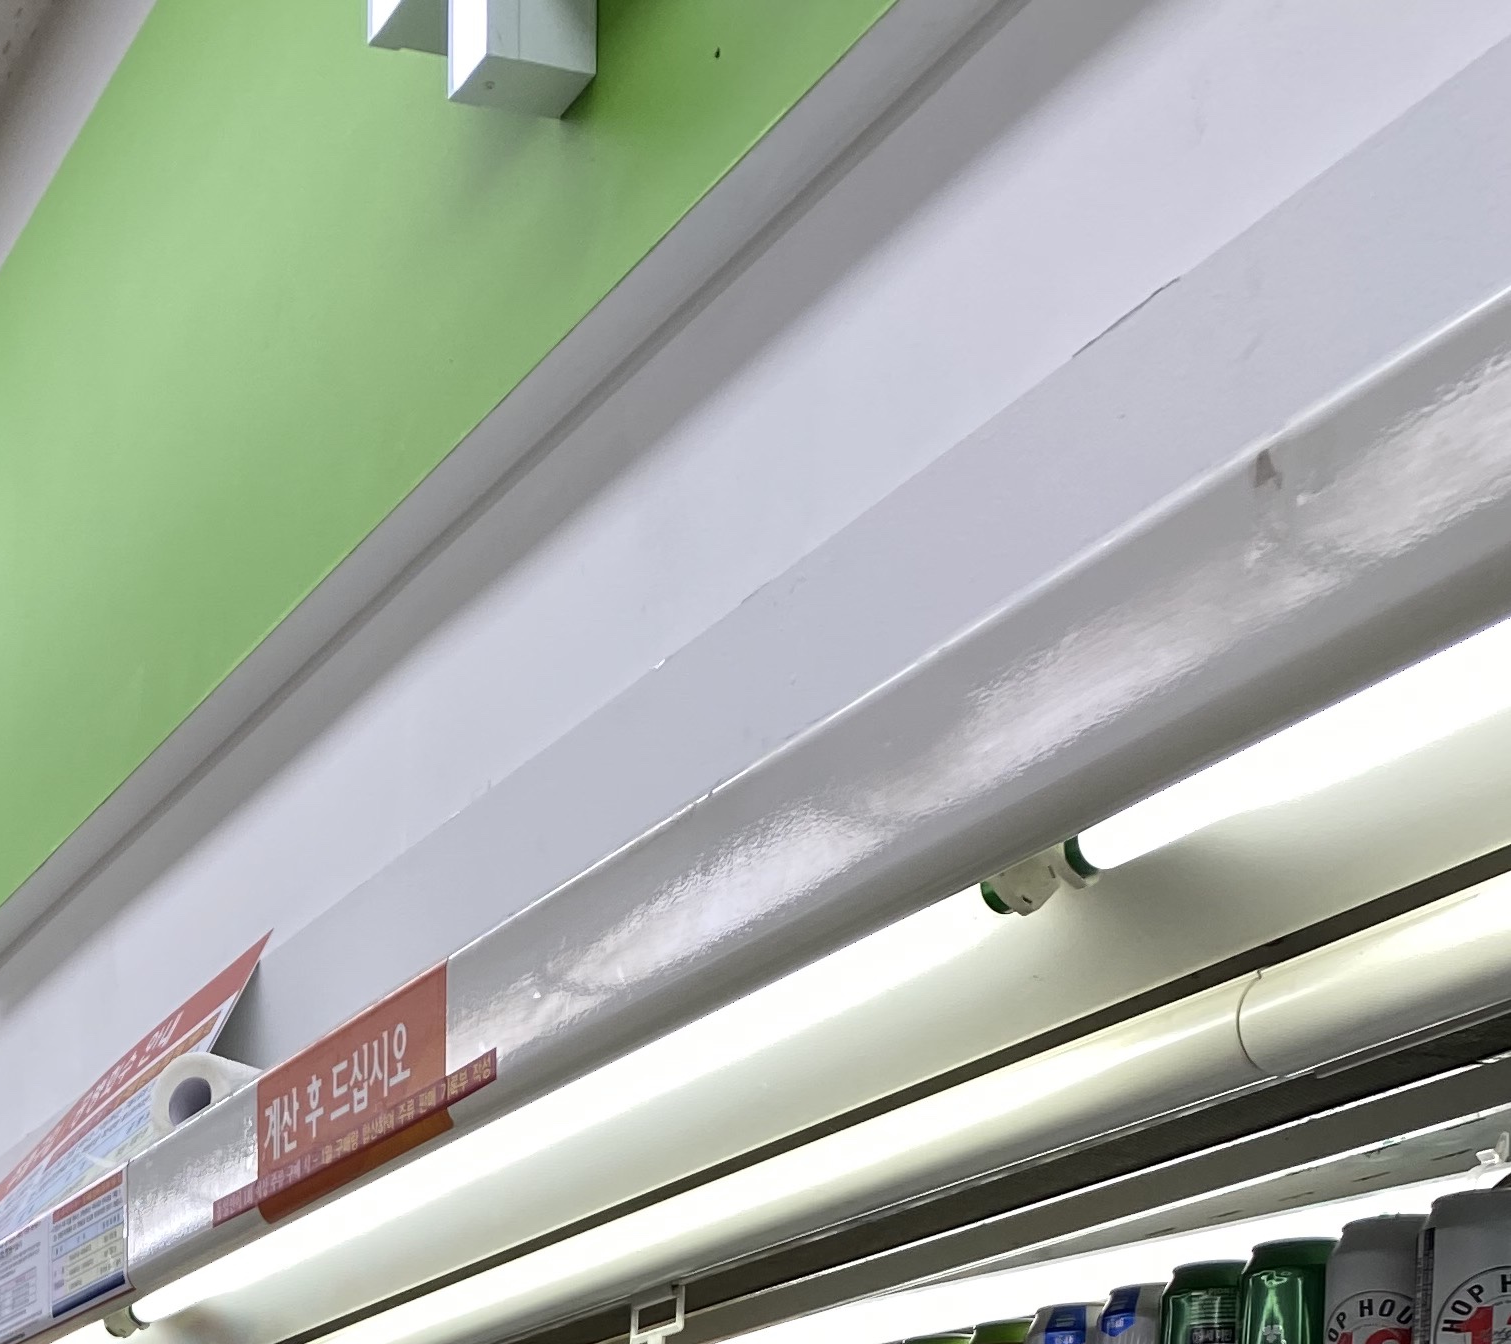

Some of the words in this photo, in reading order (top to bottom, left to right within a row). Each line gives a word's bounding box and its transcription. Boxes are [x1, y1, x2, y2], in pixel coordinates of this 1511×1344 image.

[264, 1087, 299, 1161] 계산
[305, 1074, 324, 1139] 후
[330, 1021, 410, 1121] 드십시오
[1441, 1283, 1485, 1335] HOP
